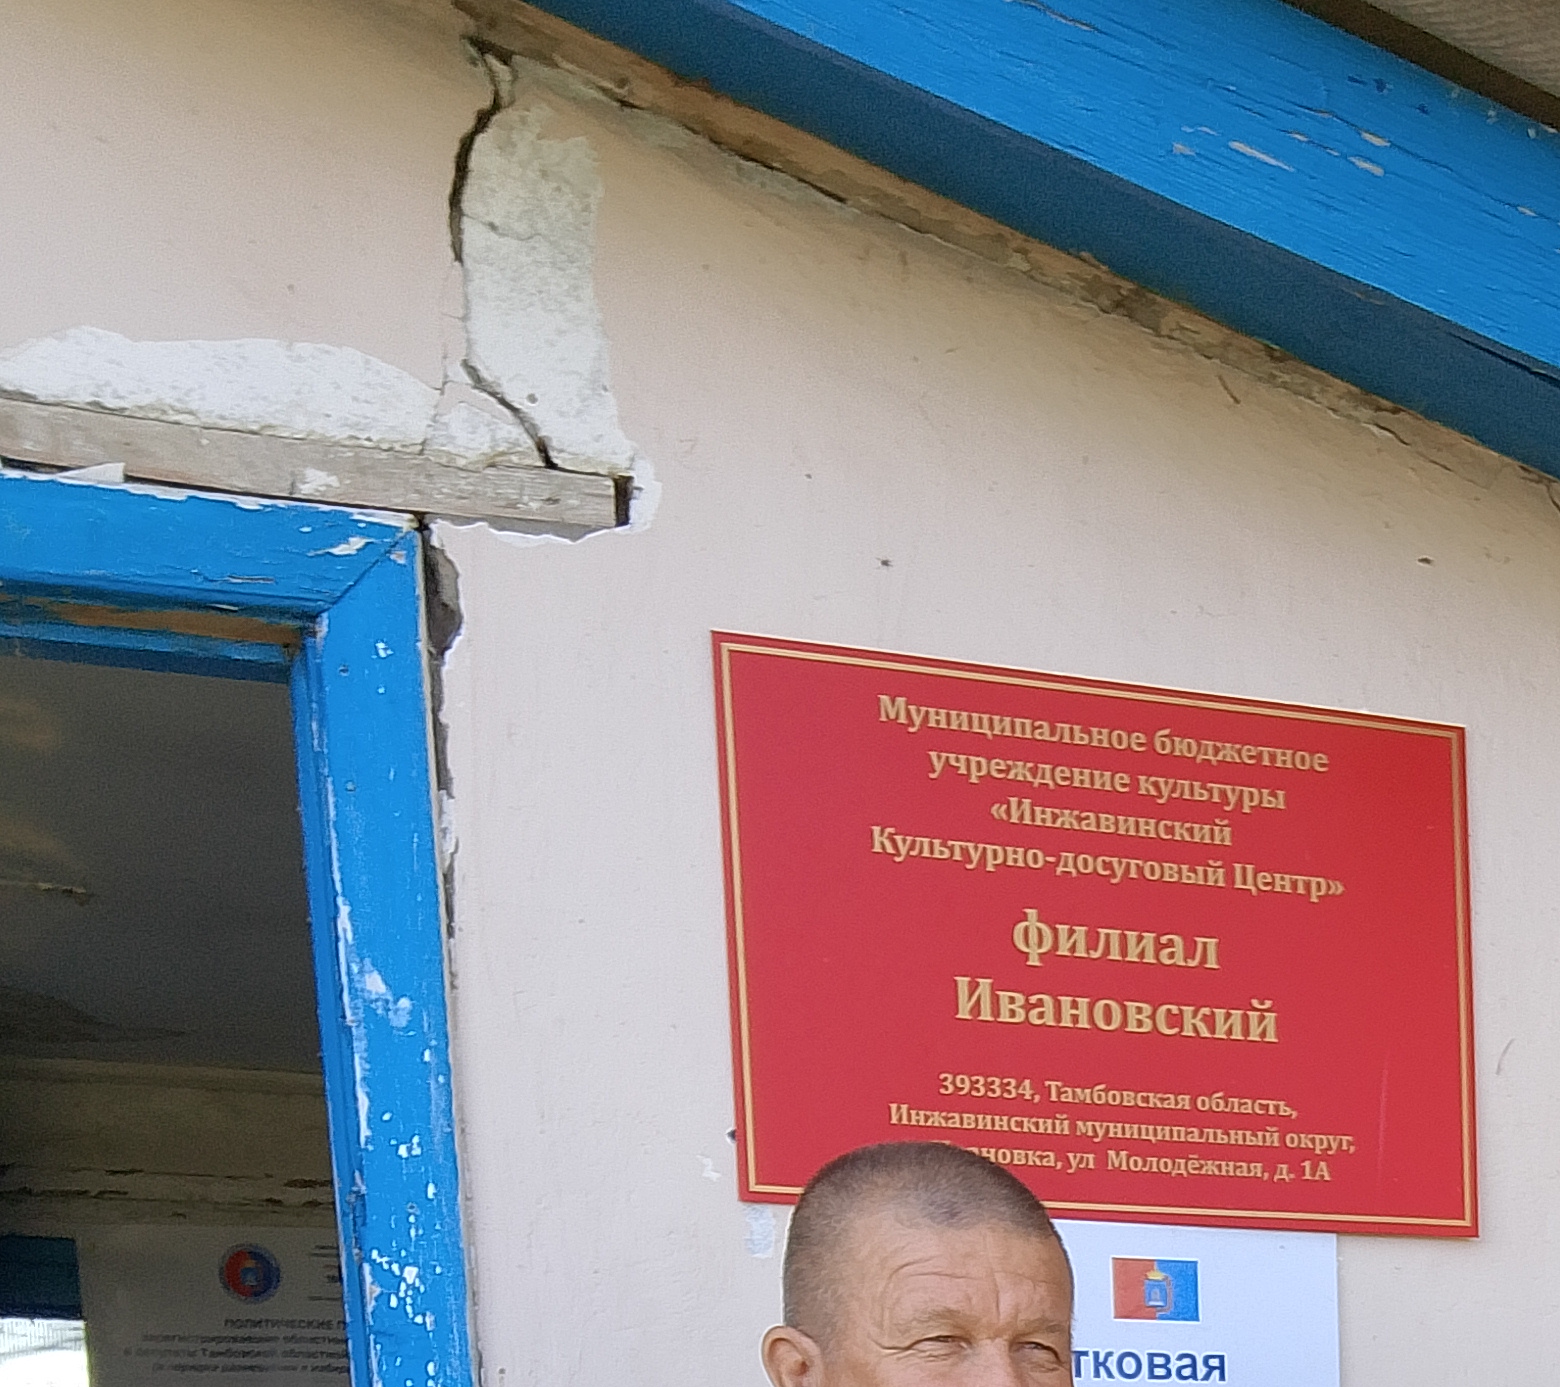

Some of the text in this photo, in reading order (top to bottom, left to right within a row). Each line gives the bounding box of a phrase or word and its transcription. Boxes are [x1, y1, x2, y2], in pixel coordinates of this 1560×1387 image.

[878, 694, 1330, 773] Муниципальное бюджетное
[927, 748, 1286, 812] учреждение культуры
[990, 797, 1232, 848] «Инжавинский
[870, 825, 1344, 902] Культурно-досуговый Центр»
[1011, 908, 1220, 971] филиал
[953, 976, 1279, 1043] Ивановский
[937, 1072, 1299, 1120] 393334, Тамбовская область,
[888, 1103, 1356, 1156] Инжавинский муниципальный округ,
[1066, 1151, 1095, 1174] ул
[1106, 1150, 1269, 1181] Молодёжная,
[1273, 1162, 1295, 1183] д.
[1300, 1160, 1331, 1183] 1А
